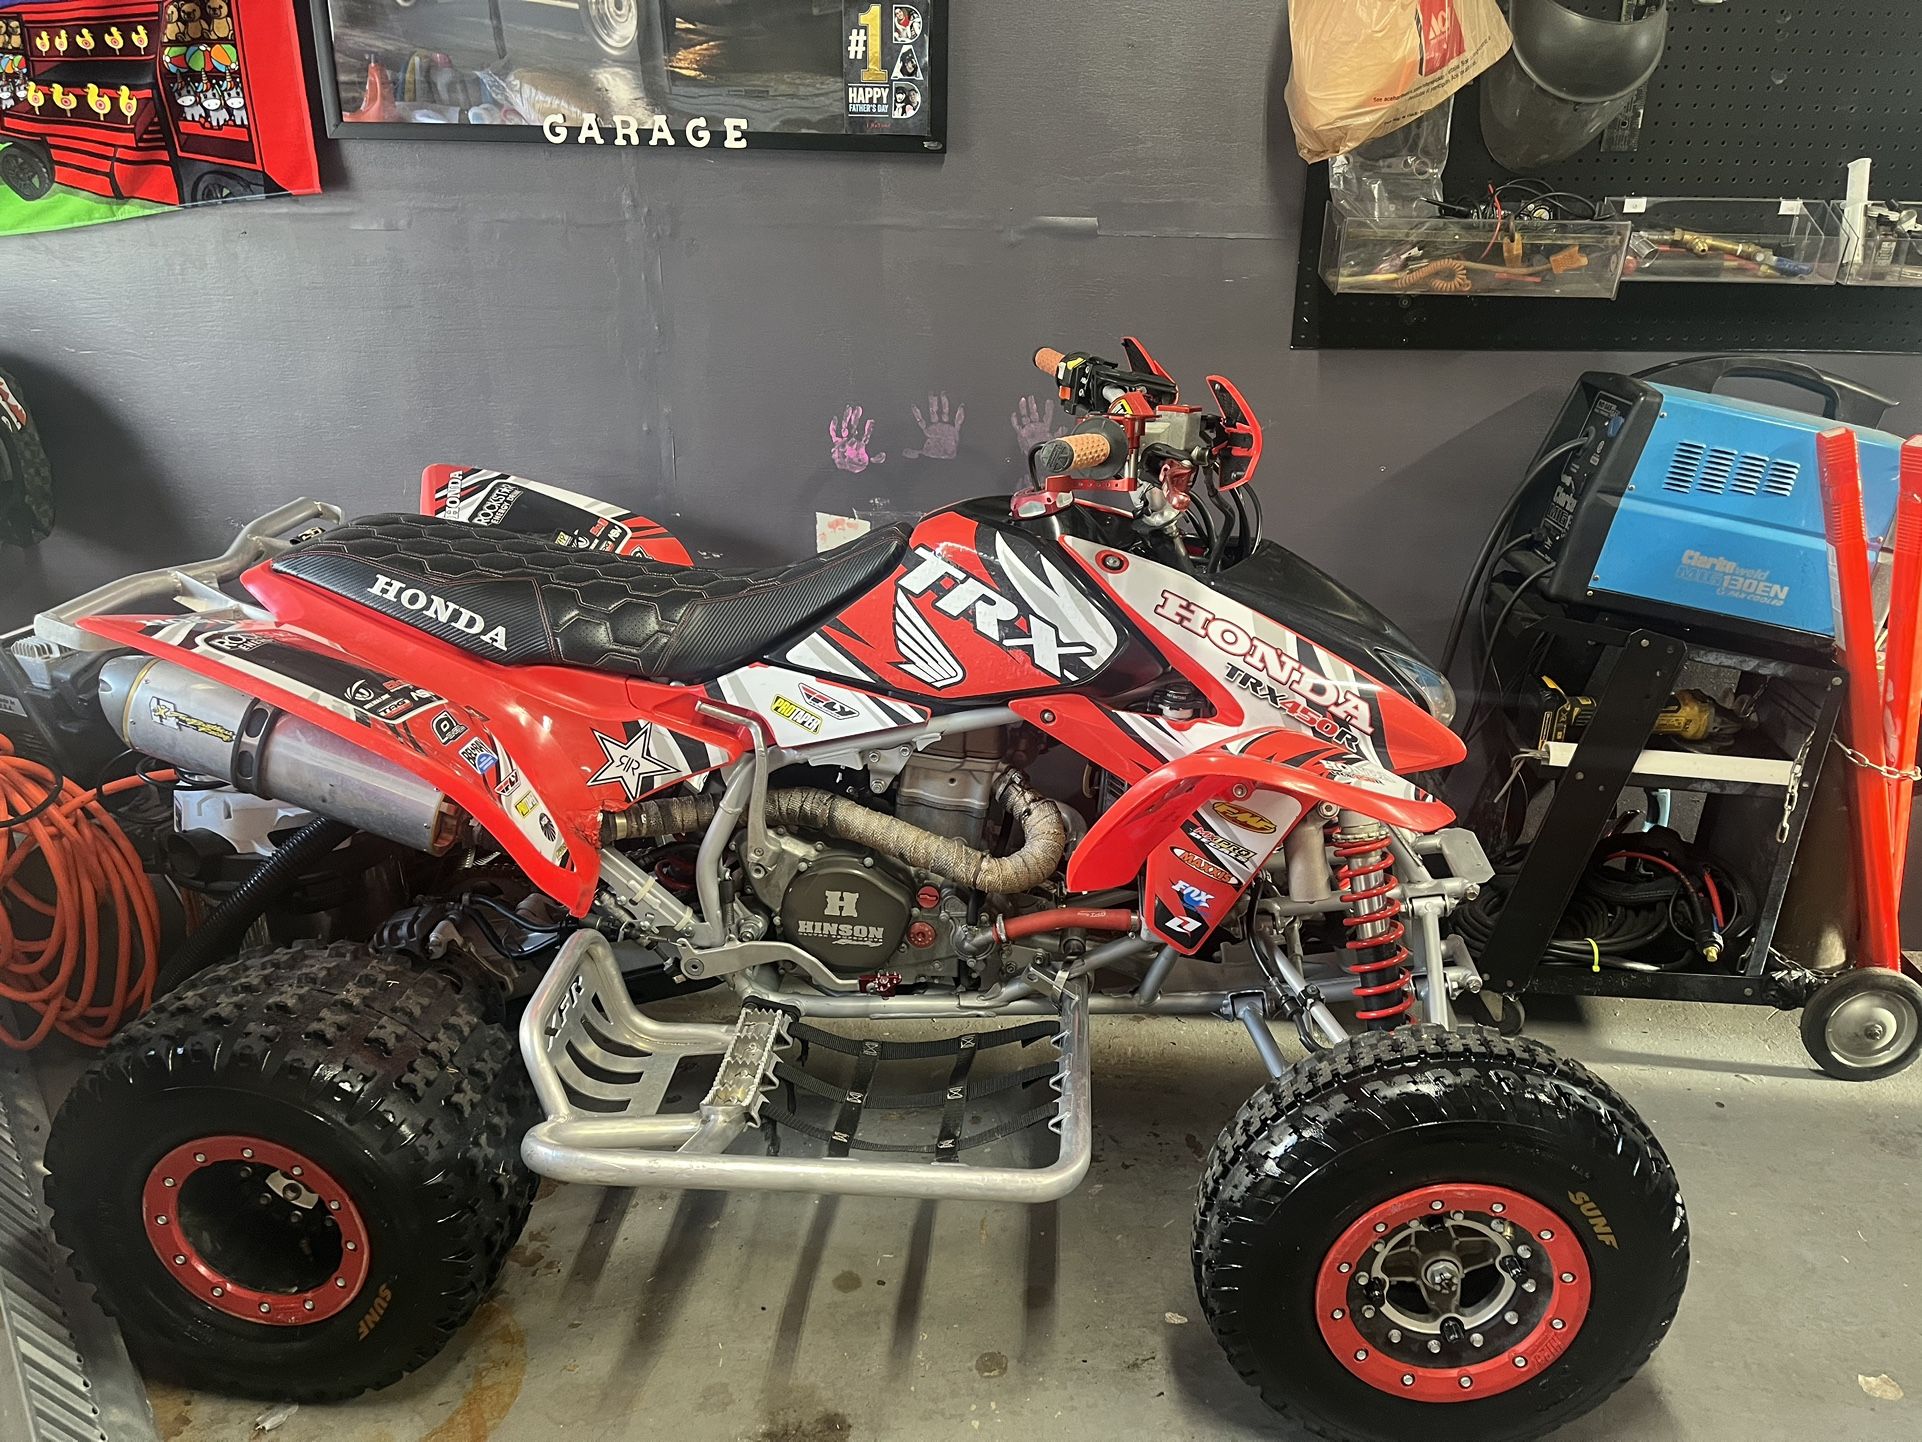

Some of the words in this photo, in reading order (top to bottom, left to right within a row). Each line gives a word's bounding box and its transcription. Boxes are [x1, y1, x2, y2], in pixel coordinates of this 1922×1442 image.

[848, 87, 890, 104] HAPPY
[848, 103, 876, 113] FATHER'S
[877, 104, 889, 113] DAY
[543, 113, 748, 149] GARAGE
[444, 470, 463, 519] HONDA
[1722, 575, 1789, 599] 130EN
[367, 573, 508, 651] HONDA
[897, 546, 1094, 679] TRX
[1154, 589, 1375, 735] HONDA
[1225, 661, 1361, 752] TRX450R
[1212, 802, 1278, 833] FMF
[1180, 851, 1233, 882] MAXXIS
[798, 921, 884, 938] HINSON
[1567, 1190, 1619, 1250] SUNF
[359, 1283, 392, 1342] SUNF
